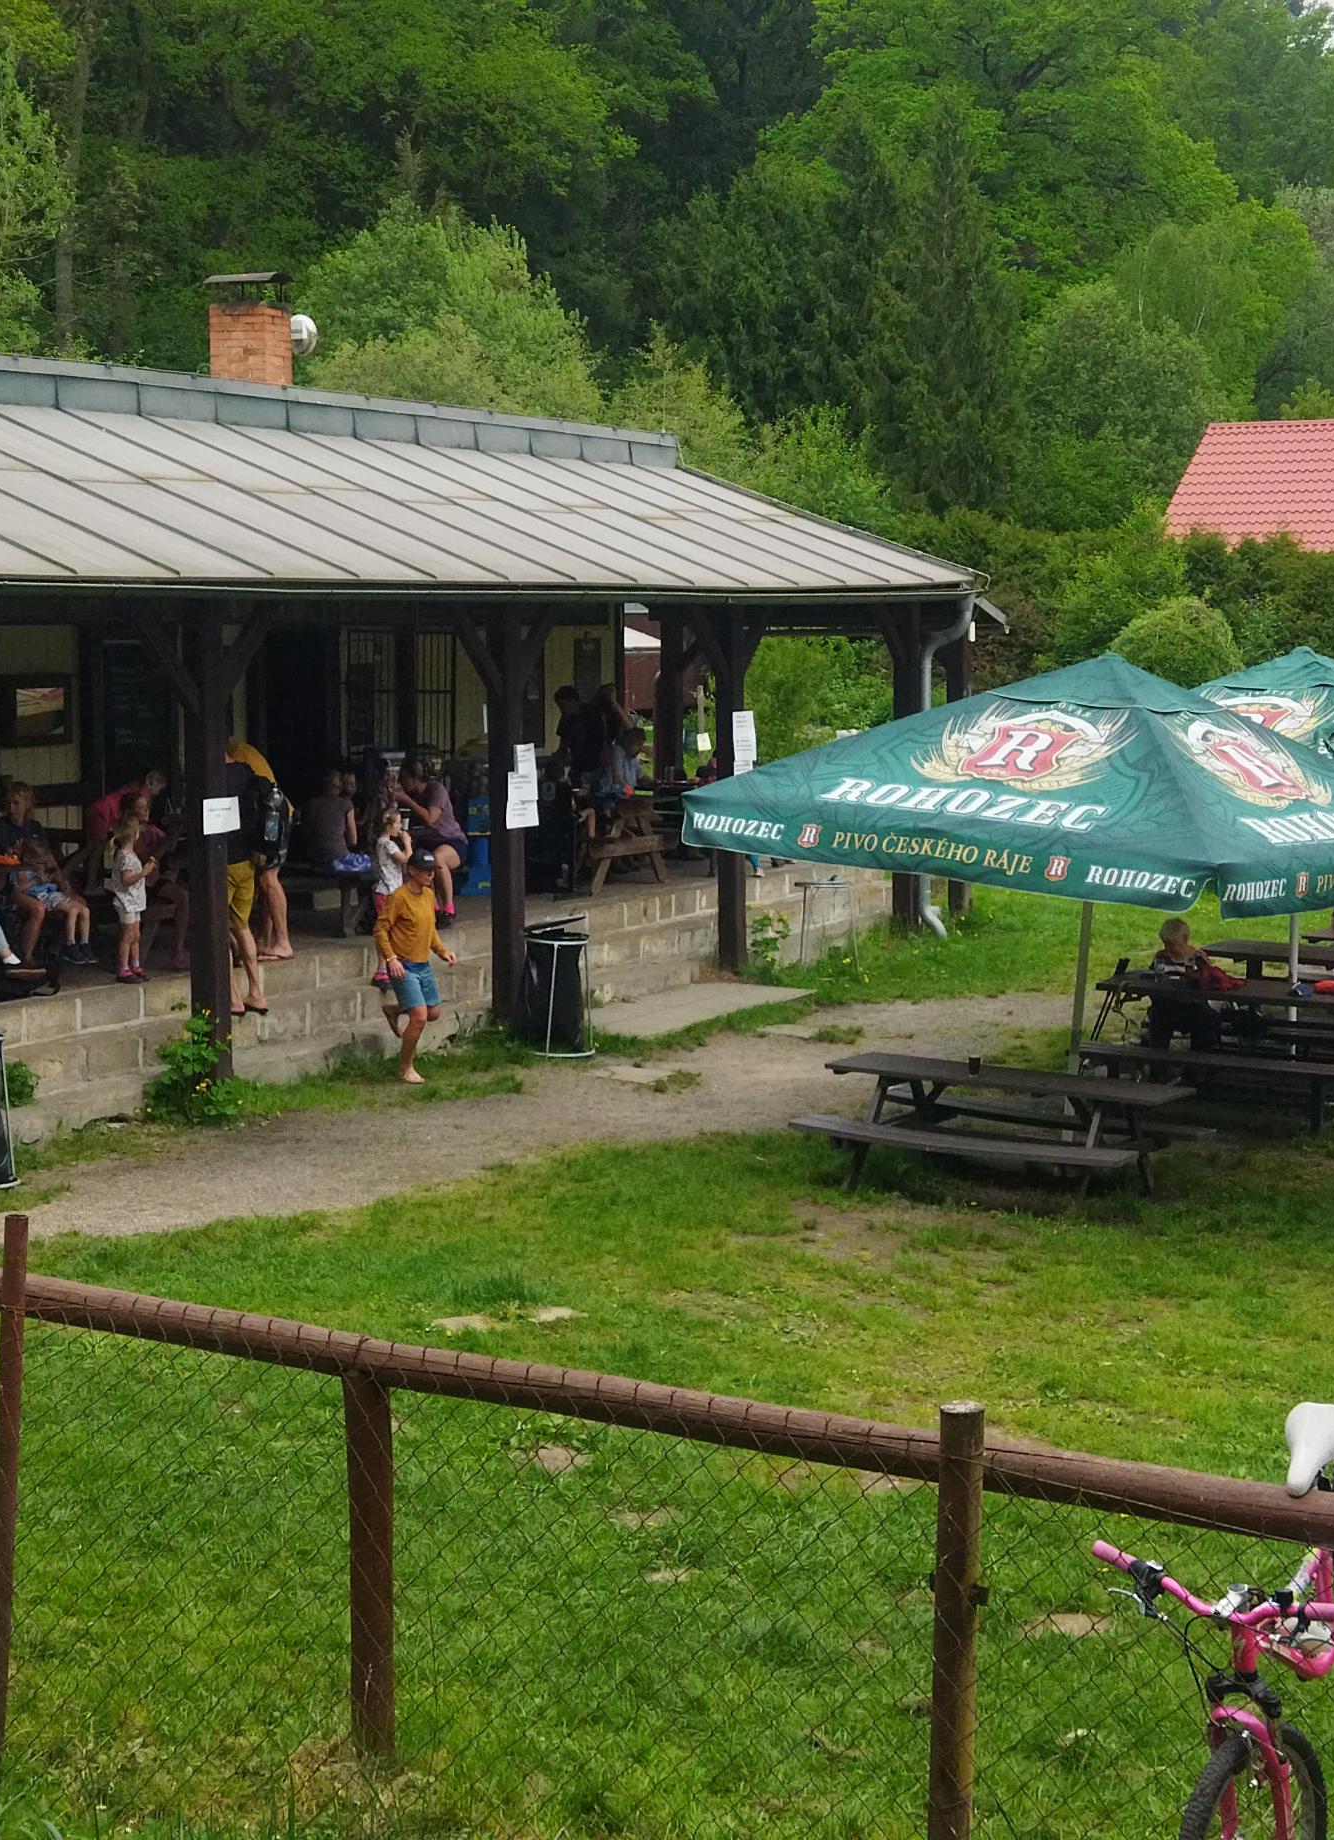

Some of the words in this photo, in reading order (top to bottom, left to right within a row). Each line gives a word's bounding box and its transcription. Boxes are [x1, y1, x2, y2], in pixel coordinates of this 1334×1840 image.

[977, 730, 1055, 772] R
[819, 777, 1110, 832] ROHOZEC
[693, 812, 785, 840] ROHOZEC
[832, 832, 879, 852] PIVO
[882, 832, 979, 864] ČESKÉHO
[982, 849, 1034, 876] RÁJE
[1084, 865, 1195, 898] ROHOZEC
[1222, 878, 1286, 902] ROHOZEC
